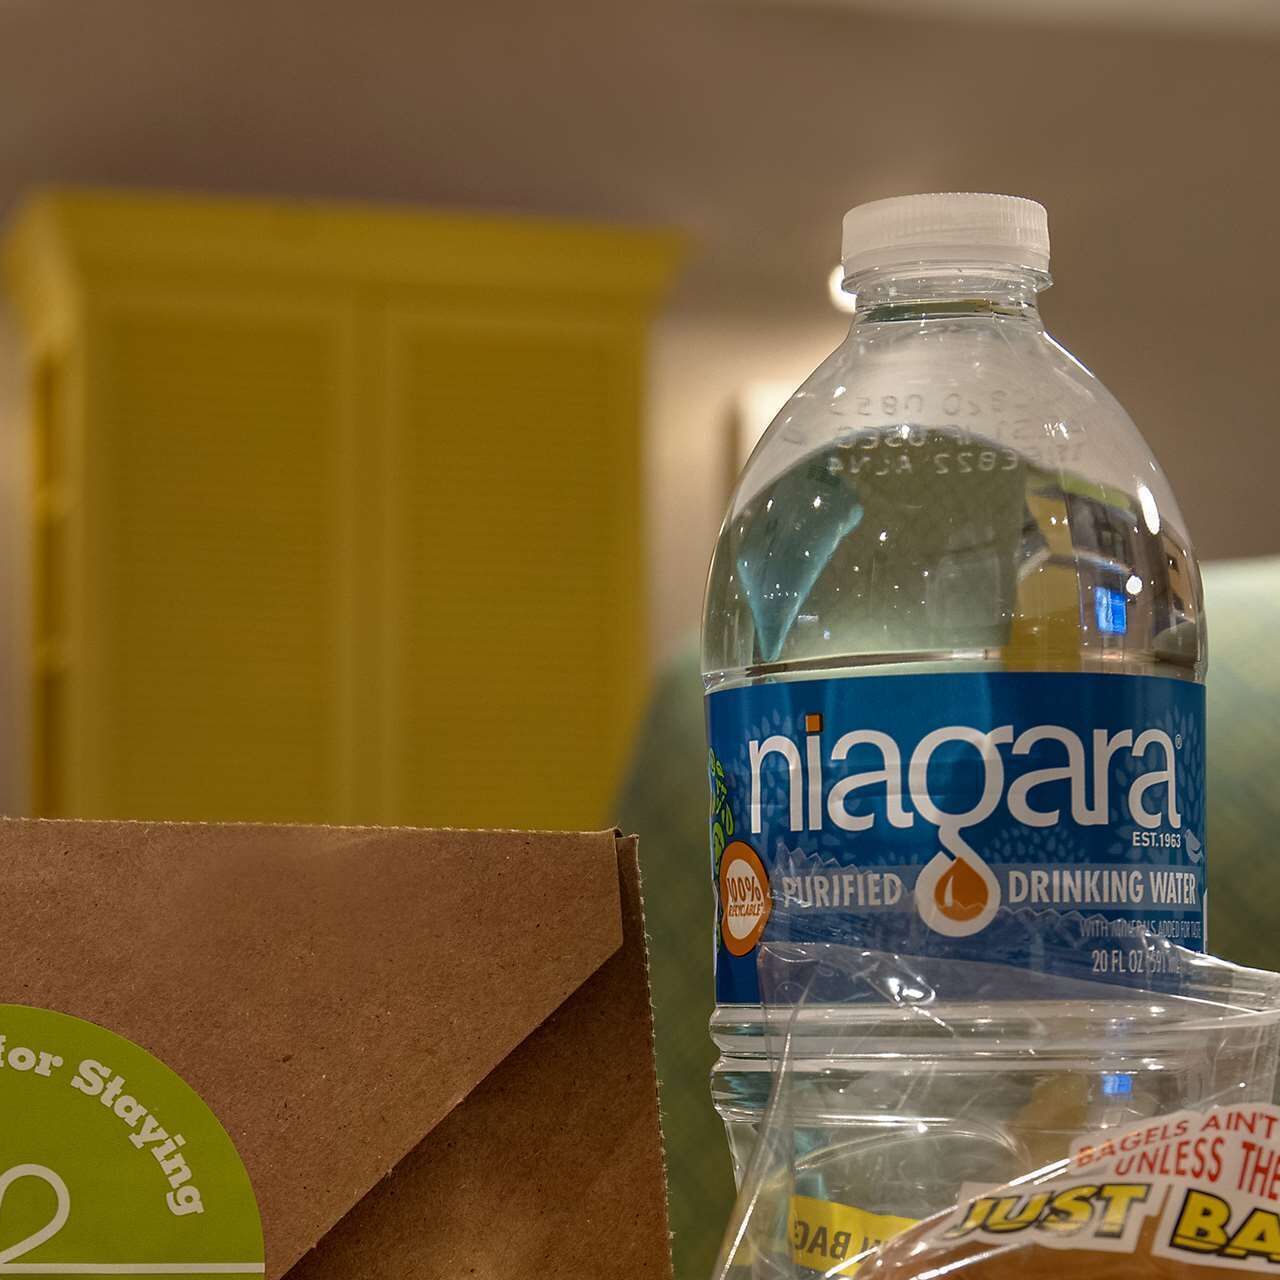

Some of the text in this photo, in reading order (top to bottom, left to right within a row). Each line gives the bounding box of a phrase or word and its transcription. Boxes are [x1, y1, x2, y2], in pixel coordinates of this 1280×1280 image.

[748, 713, 1181, 937] niagara
[1132, 831, 1181, 848] EST.1963
[726, 876, 762, 904] 100%
[782, 870, 1196, 908] PURIFIED DRINKING WATER
[1092, 950, 1107, 972] 20
[1111, 950, 1126, 972] FL
[1129, 950, 1143, 972] OZ
[70, 1059, 205, 1217] Staying
[1075, 1120, 1189, 1169] BAGELS
[1202, 1111, 1279, 1139] AIN'T
[1114, 1138, 1225, 1183] UNLESS
[942, 1183, 1152, 1240] JUST
